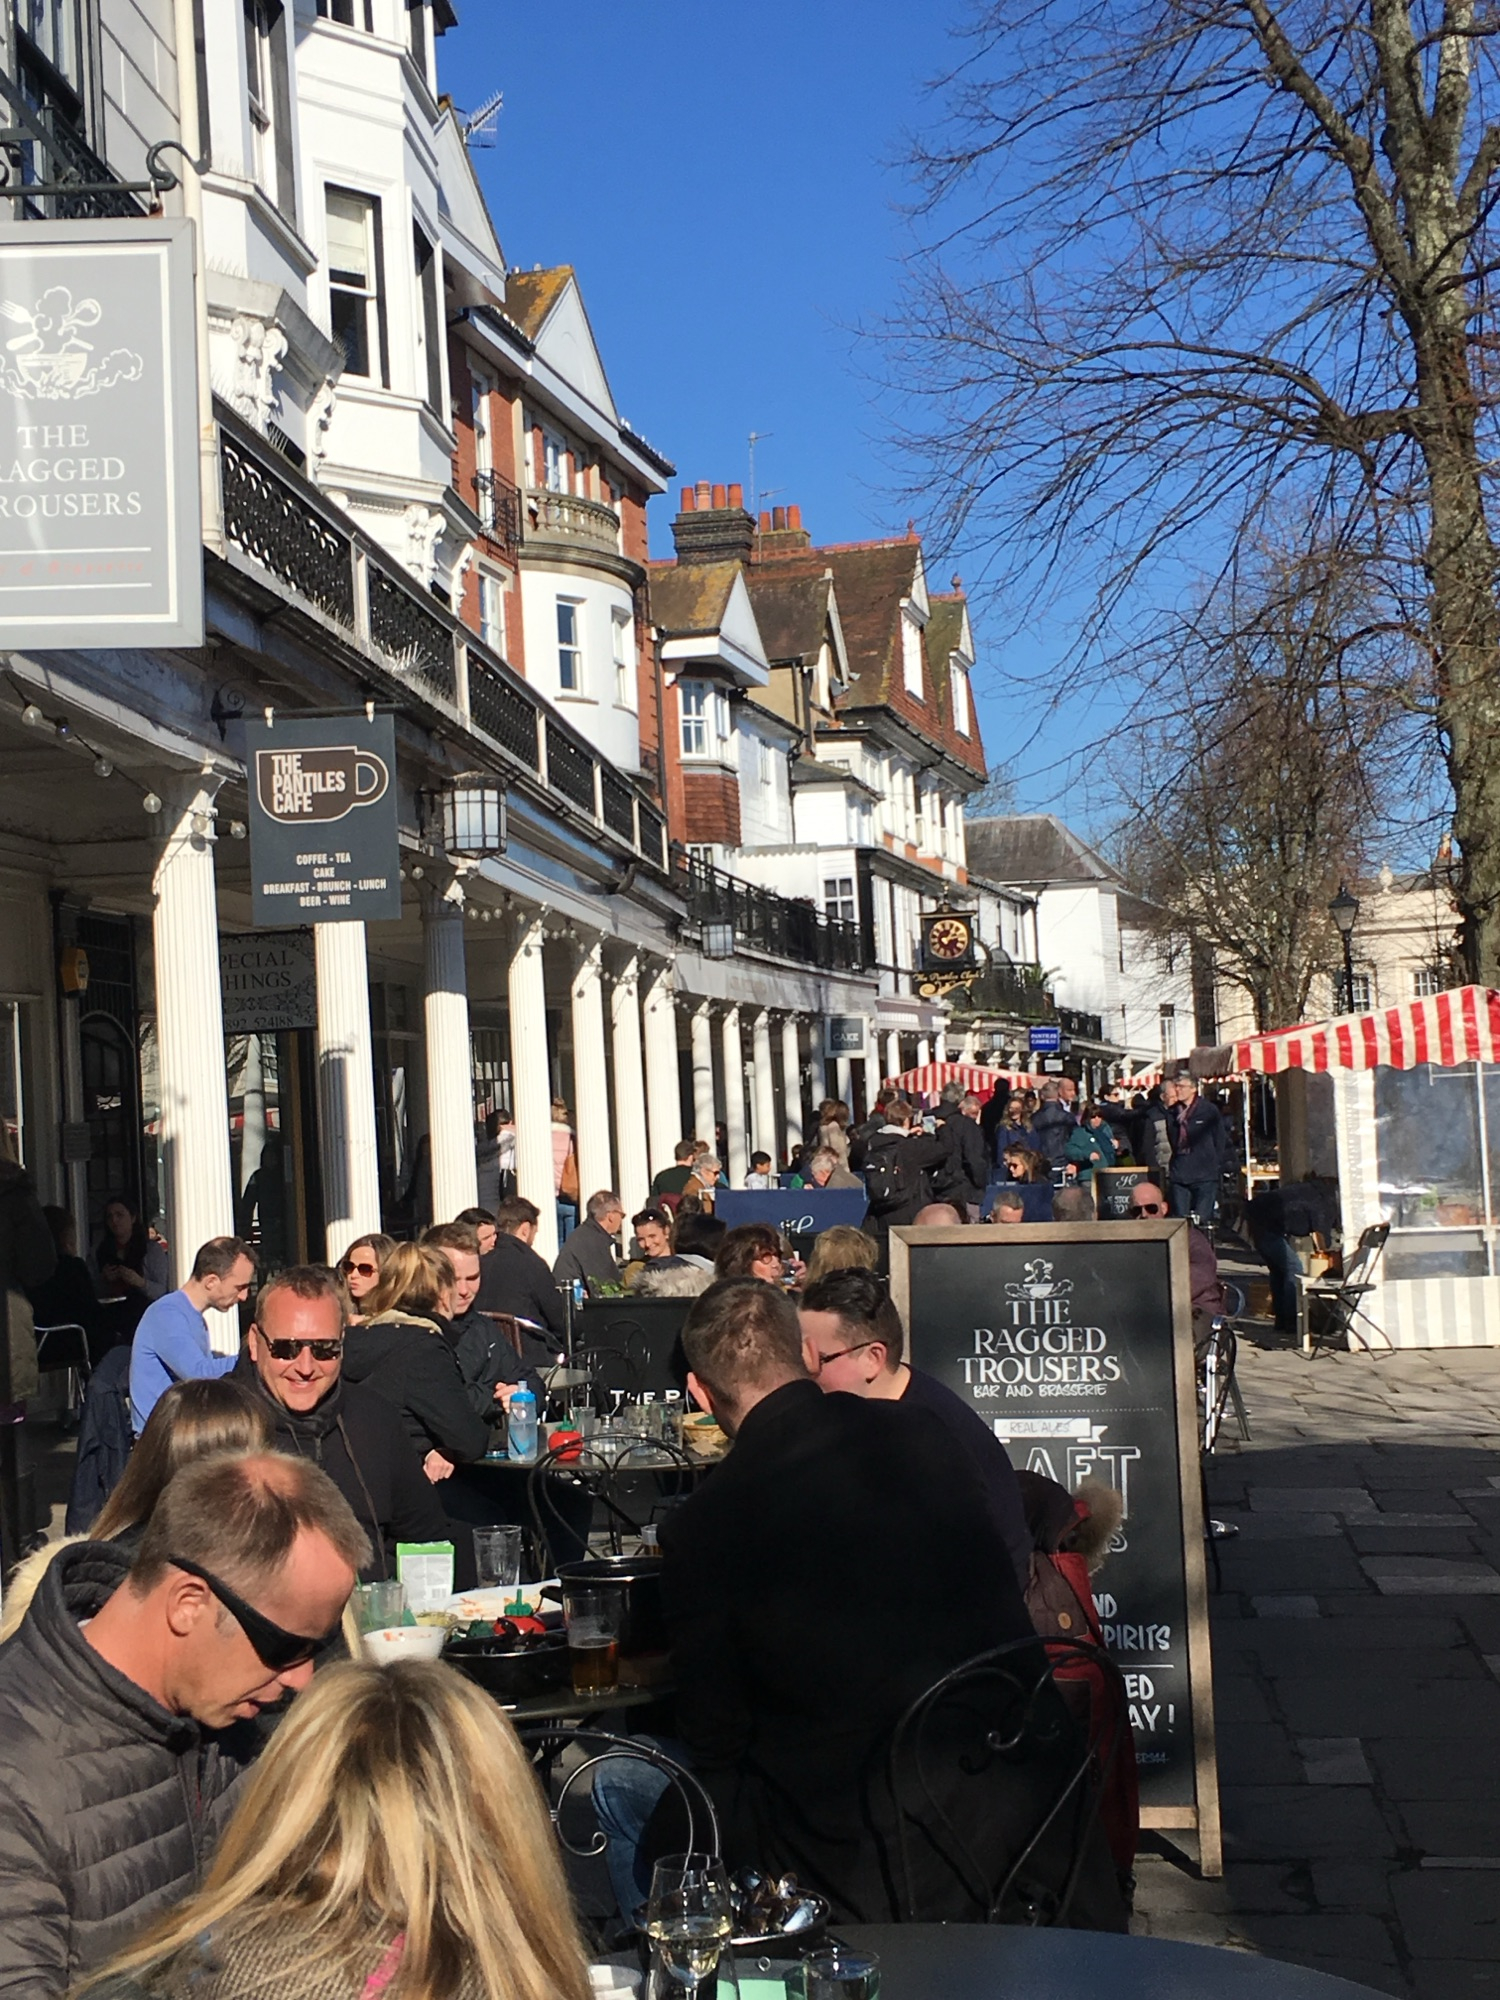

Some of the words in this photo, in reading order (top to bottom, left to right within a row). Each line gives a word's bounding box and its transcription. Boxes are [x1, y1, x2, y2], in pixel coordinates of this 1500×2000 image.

[17, 424, 90, 449] THE
[0, 491, 142, 518] ROUSERS
[271, 754, 302, 774] THE
[272, 771, 346, 794] PANTILES
[273, 792, 313, 813] CAFE
[296, 853, 328, 865] COFFEE
[335, 852, 351, 864] TEA
[313, 867, 335, 878] CAKE
[263, 882, 310, 895] BREAKFAST
[317, 880, 351, 892] BRUNCH
[358, 879, 387, 890] LUNCH
[300, 896, 321, 907] BEER
[328, 894, 351, 906] WINE
[221, 950, 294, 969] PECIAL
[224, 971, 291, 990] HINGS
[1005, 1299, 1072, 1325] THE
[973, 1326, 1107, 1354] RAGGED
[957, 1355, 1121, 1384] TROUSERS
[973, 1384, 1000, 1398] BAR
[1005, 1384, 1034, 1398] AND
[1038, 1383, 1108, 1398] BRASSERIE
[1009, 1421, 1037, 1434] REAL
[1099, 1623, 1171, 1651] PIRITS
